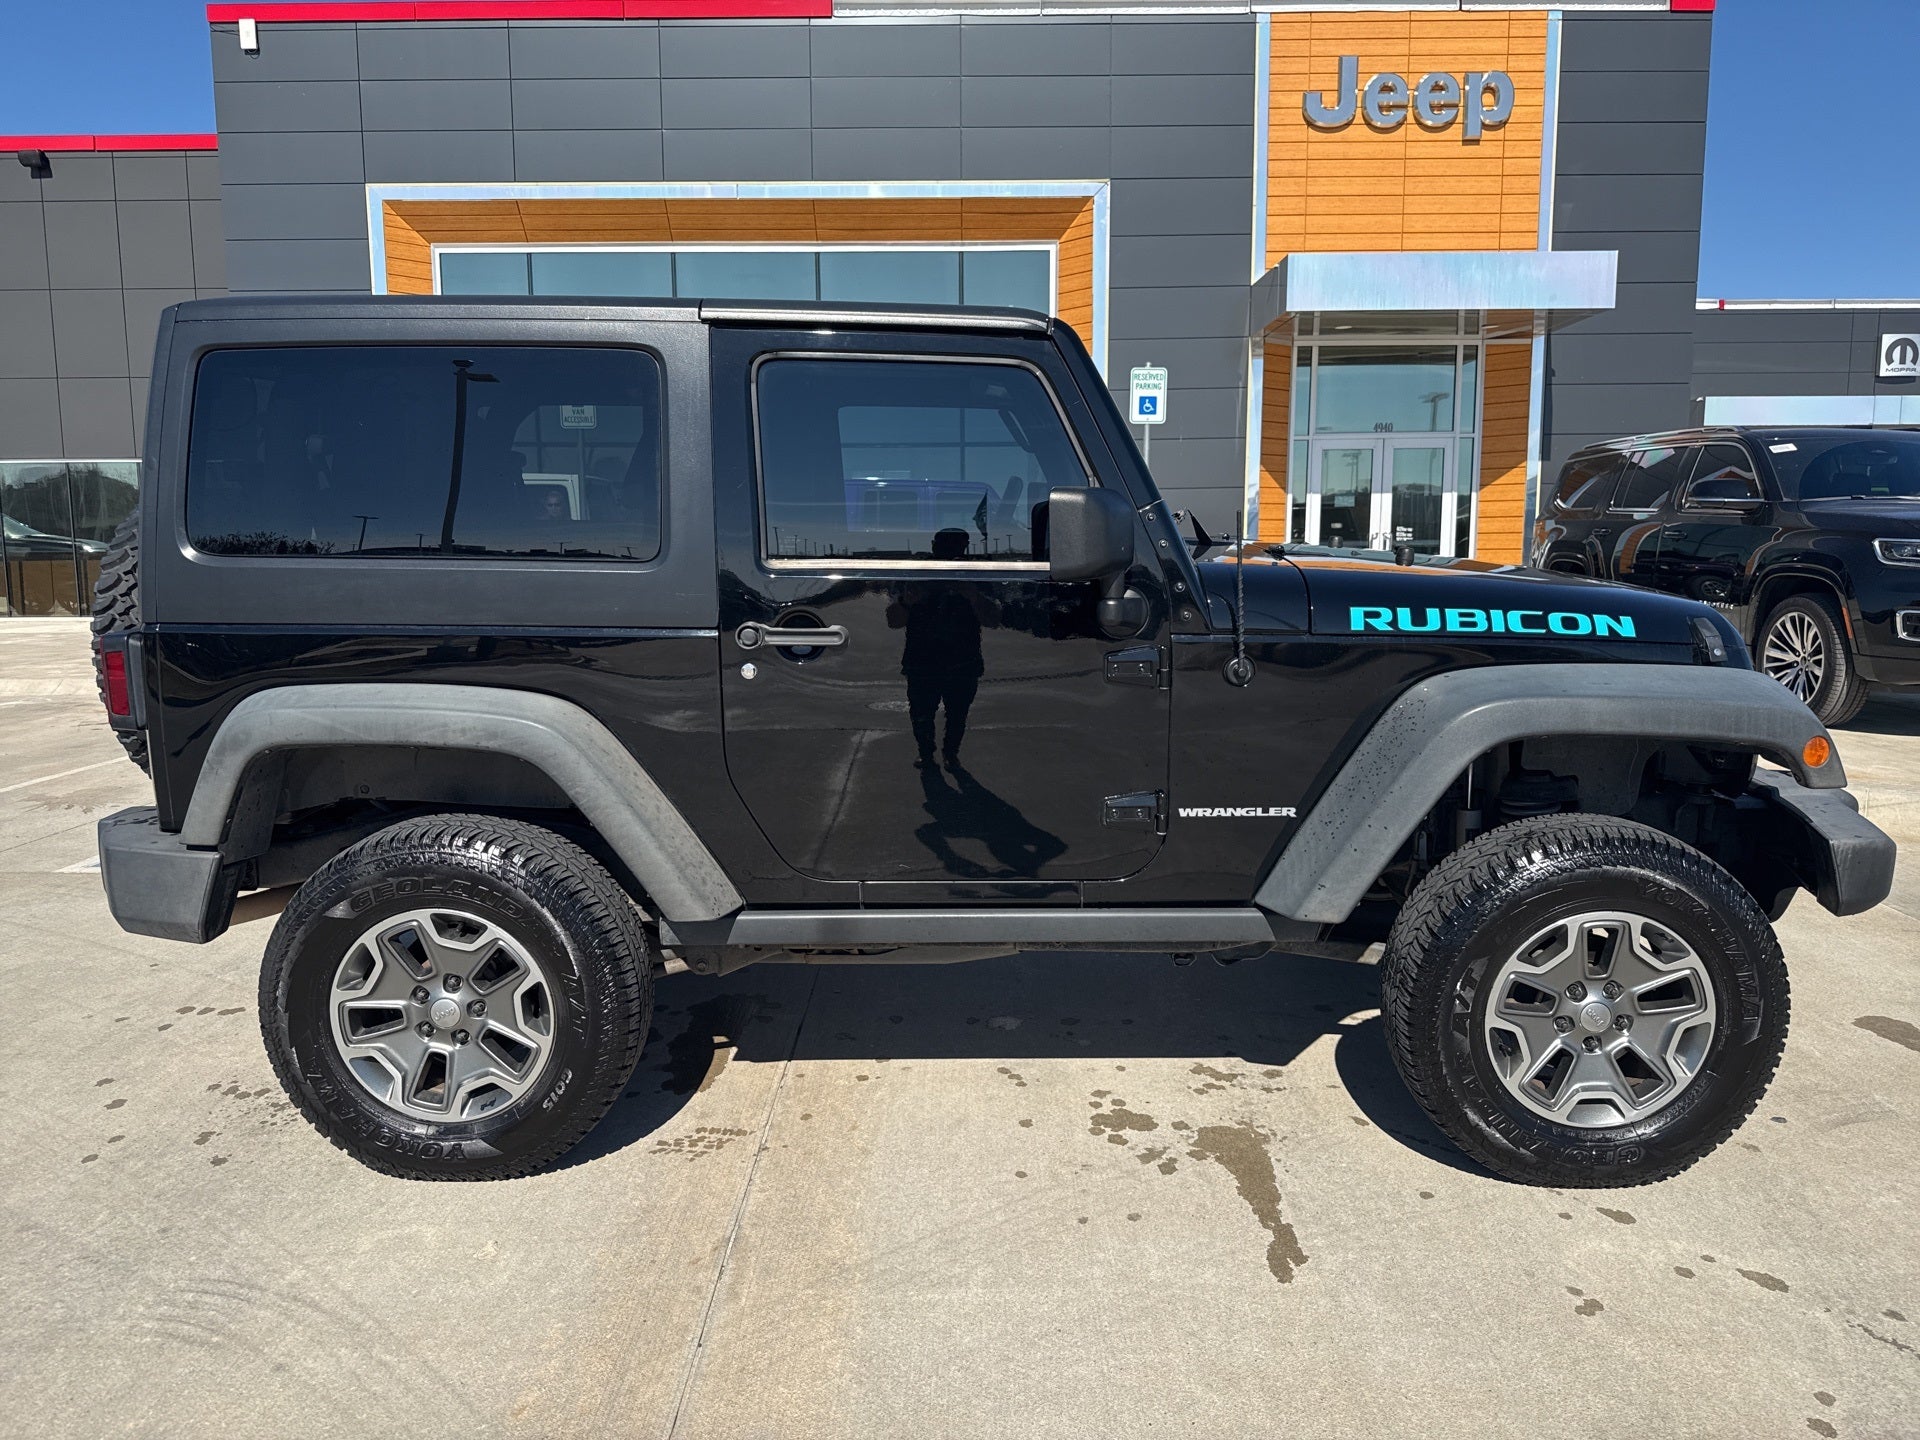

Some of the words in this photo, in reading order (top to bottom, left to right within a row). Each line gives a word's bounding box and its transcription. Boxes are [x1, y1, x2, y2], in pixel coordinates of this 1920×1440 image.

[1302, 54, 1515, 140] Jeep
[1133, 373, 1165, 381] RESERVED
[564, 415, 593, 423] ACCESSIBLE
[1373, 422, 1393, 433] 4940
[1350, 606, 1636, 637] RUBICON
[1178, 807, 1297, 818] WRANGLER
